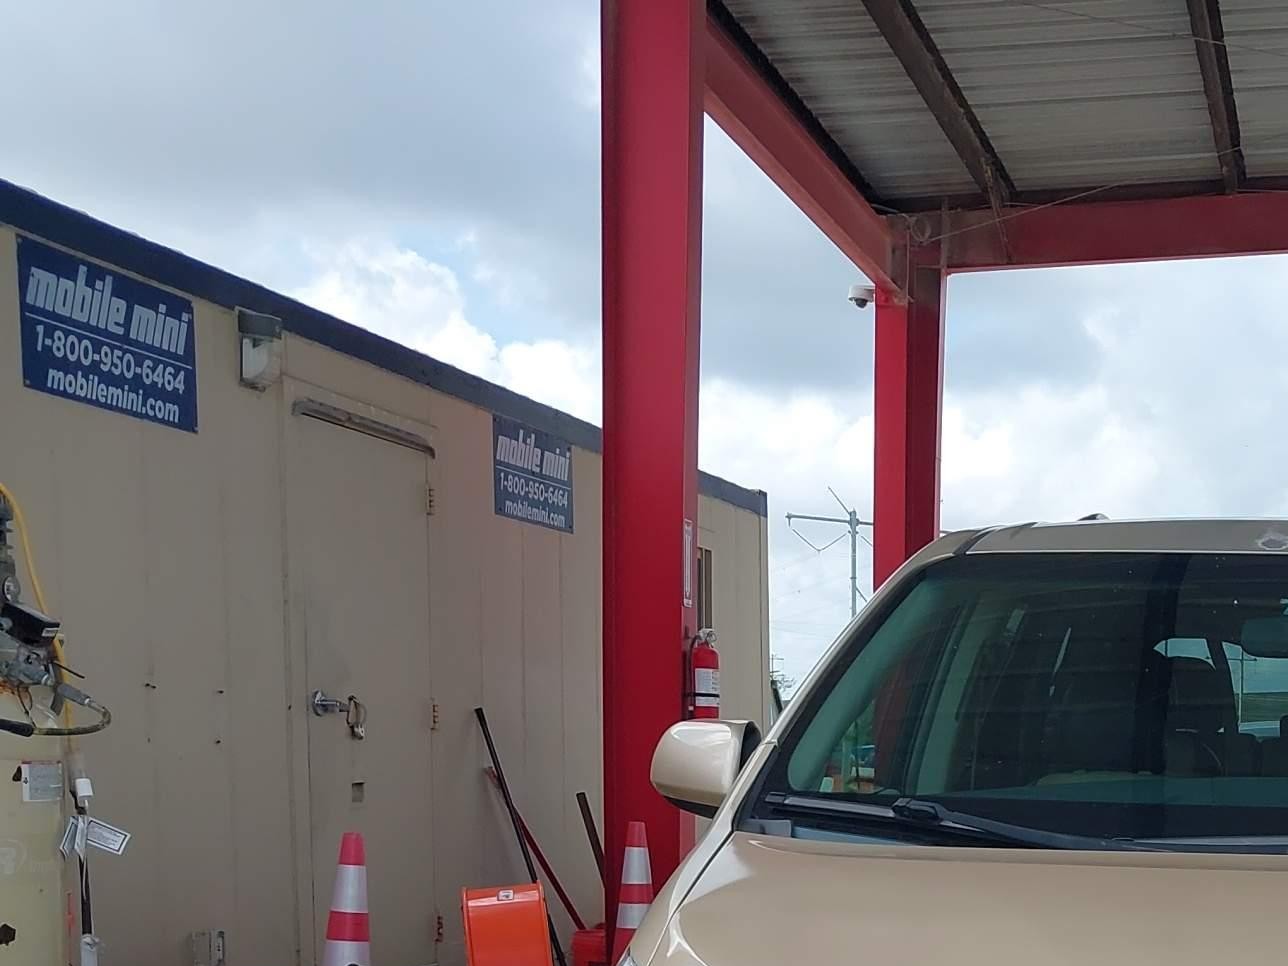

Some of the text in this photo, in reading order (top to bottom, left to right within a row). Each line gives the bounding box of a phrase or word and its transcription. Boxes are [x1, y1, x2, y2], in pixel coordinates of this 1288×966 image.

[26, 264, 190, 356] mobile mini
[36, 324, 185, 395] 1-800-950-6464
[47, 368, 180, 423] mobilemini.com
[496, 429, 570, 481] mobile mini
[500, 472, 568, 508] 1-800-950-6464
[505, 500, 566, 528] mobilemini.com
